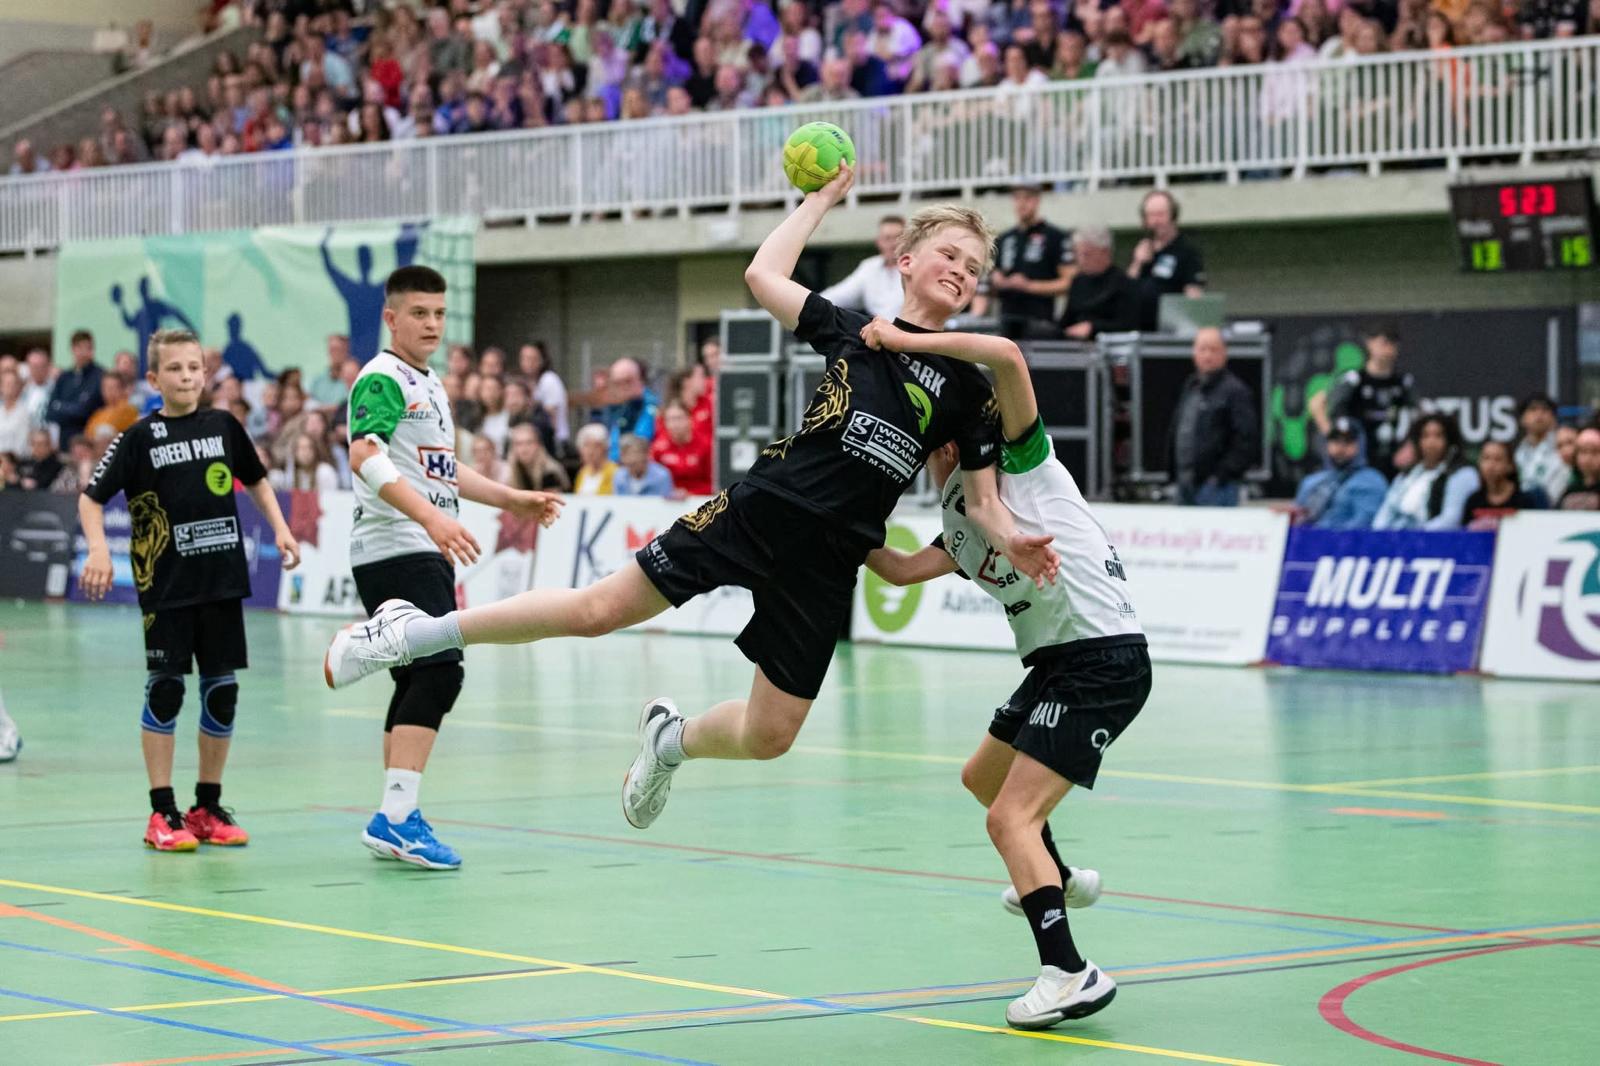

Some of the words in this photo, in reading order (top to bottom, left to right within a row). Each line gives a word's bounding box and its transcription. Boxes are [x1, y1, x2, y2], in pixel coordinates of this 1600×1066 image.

[1560, 234, 1592, 267] 15
[150, 422, 168, 439] 33
[879, 425, 917, 455] WOON
[149, 441, 192, 469] GREEN
[192, 436, 225, 460] PARK
[842, 445, 905, 484] VOLMACHT
[874, 434, 917, 466] GARANT
[194, 521, 227, 532] WOON
[194, 527, 233, 538] GARANT
[181, 544, 237, 557] VOLMACHT
[1306, 555, 1457, 611] MULTI
[1271, 614, 1469, 643] SUPPLIES
[1044, 908, 1062, 920] NIKE
